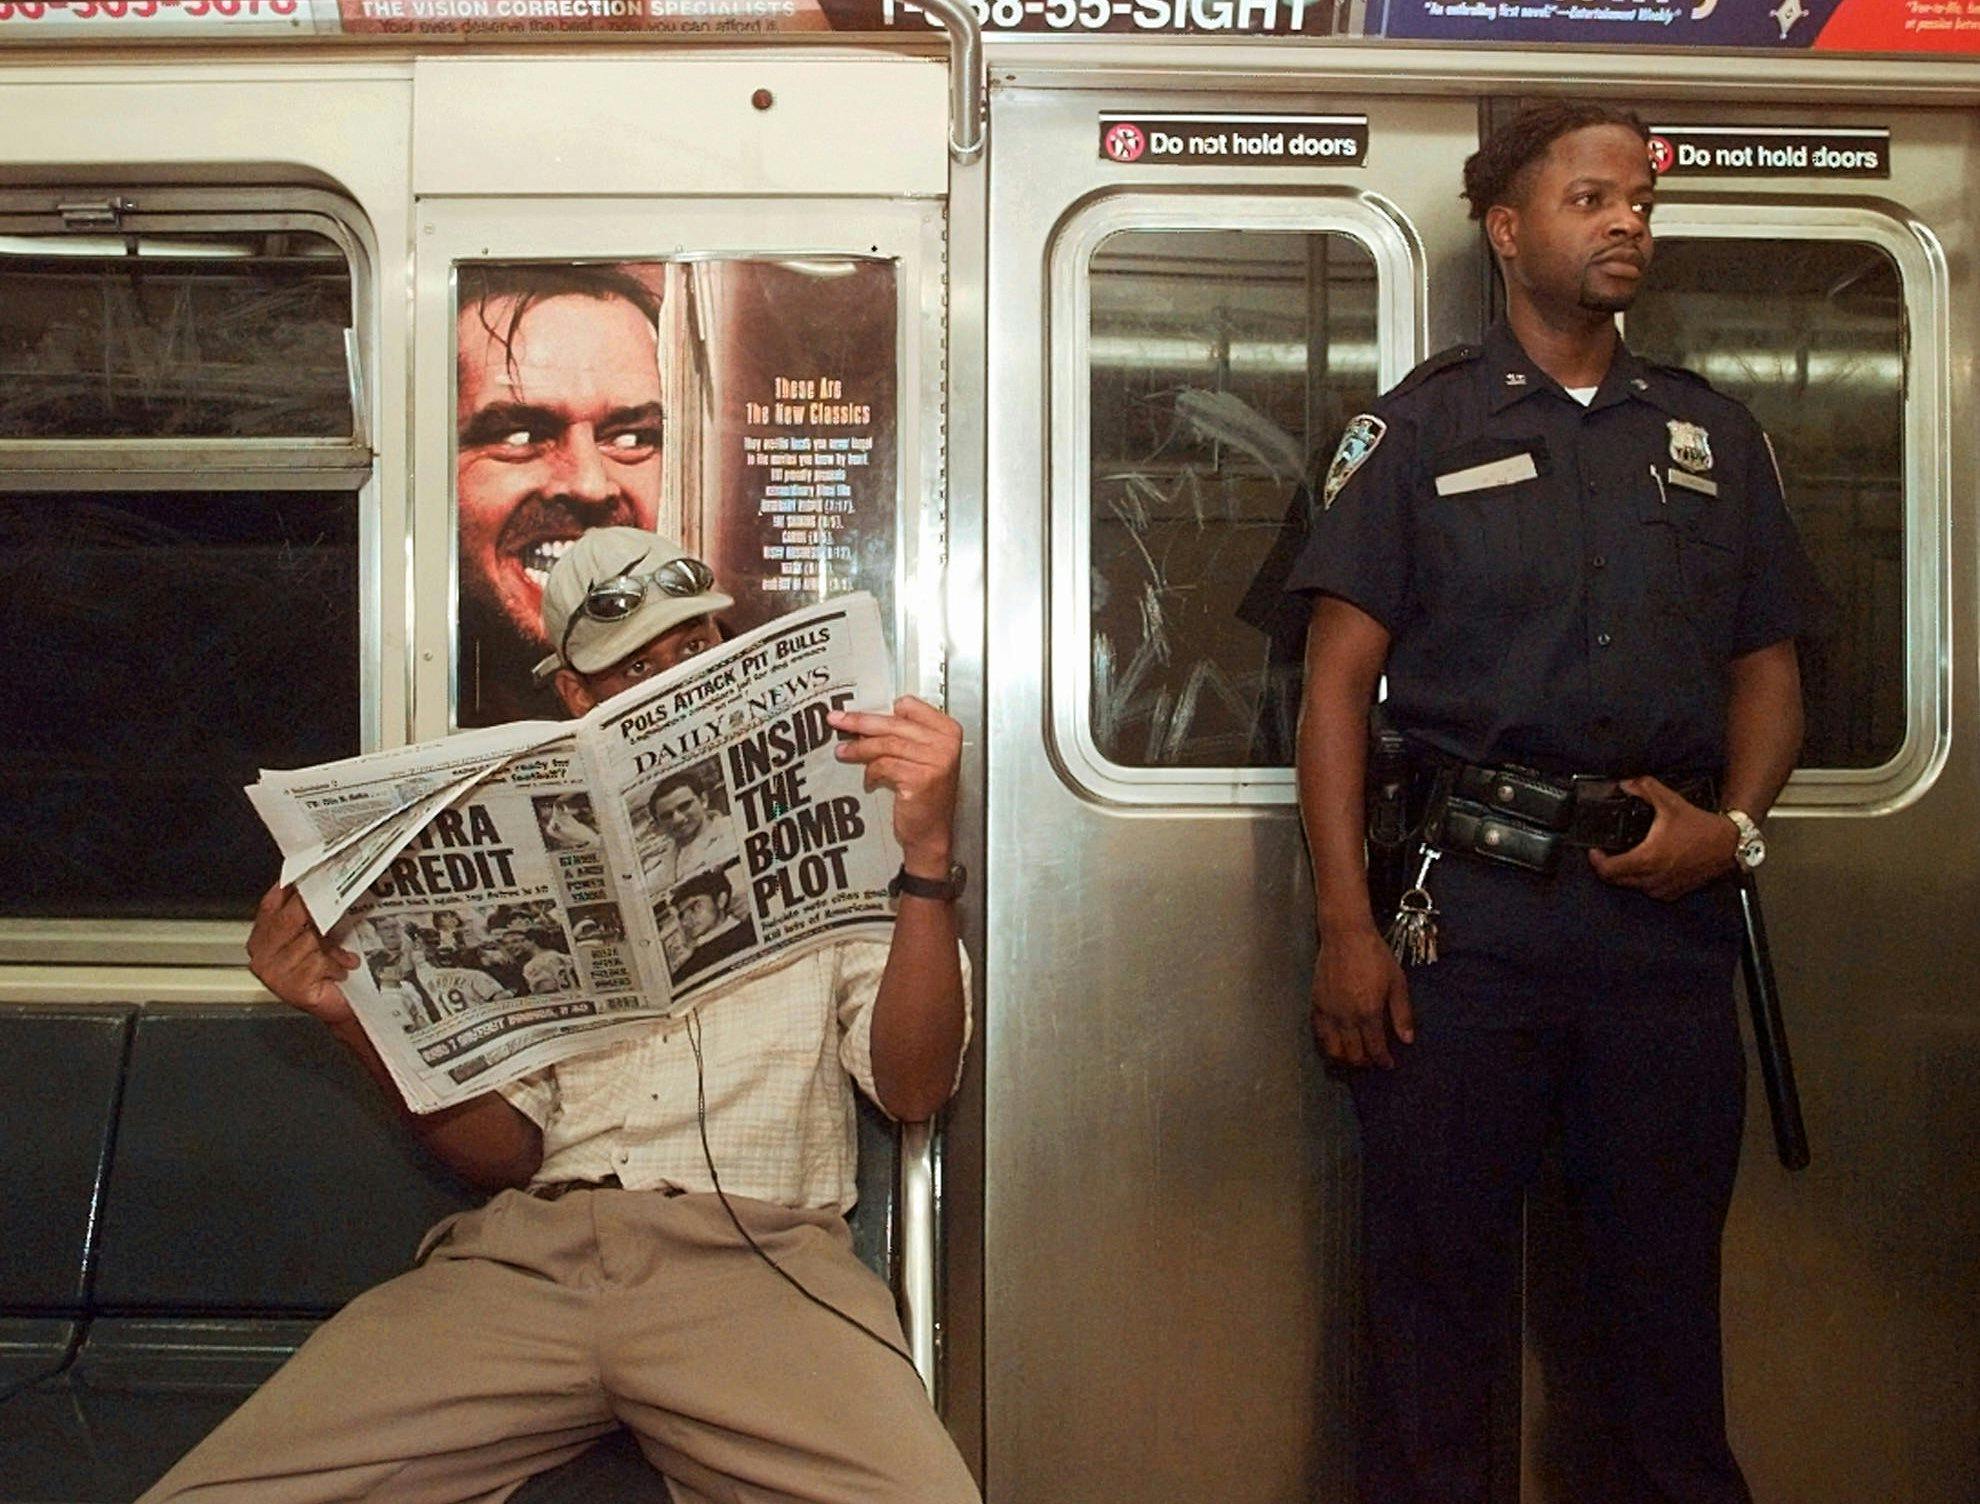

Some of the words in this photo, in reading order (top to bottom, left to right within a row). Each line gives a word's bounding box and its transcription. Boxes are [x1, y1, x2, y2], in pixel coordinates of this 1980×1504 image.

[362, 0, 404, 16] THE
[413, 0, 487, 16] VISION
[497, 0, 643, 16] CORRECTION
[651, 0, 795, 17] SPECIALISTS
[1150, 132, 1183, 154] Do
[1189, 133, 1228, 154] not
[1232, 132, 1284, 155] hold
[1288, 133, 1357, 156] doors
[1679, 144, 1711, 166] Do
[1716, 146, 1752, 167] not
[1758, 145, 1807, 168] hold
[1812, 146, 1879, 169] doors
[775, 377, 815, 399] These
[820, 377, 841, 399] Are
[746, 402, 769, 425] The
[775, 402, 805, 425] New
[809, 402, 870, 425] Classics
[621, 704, 668, 739] POLS
[674, 670, 736, 712] ATTACK
[741, 652, 768, 677] PIT
[776, 628, 830, 660] BULLS
[633, 713, 724, 775] DAILY
[748, 665, 830, 720] NEWS
[735, 761, 812, 832] THE
[745, 795, 865, 877] BOMB
[752, 846, 849, 919] PLOT
